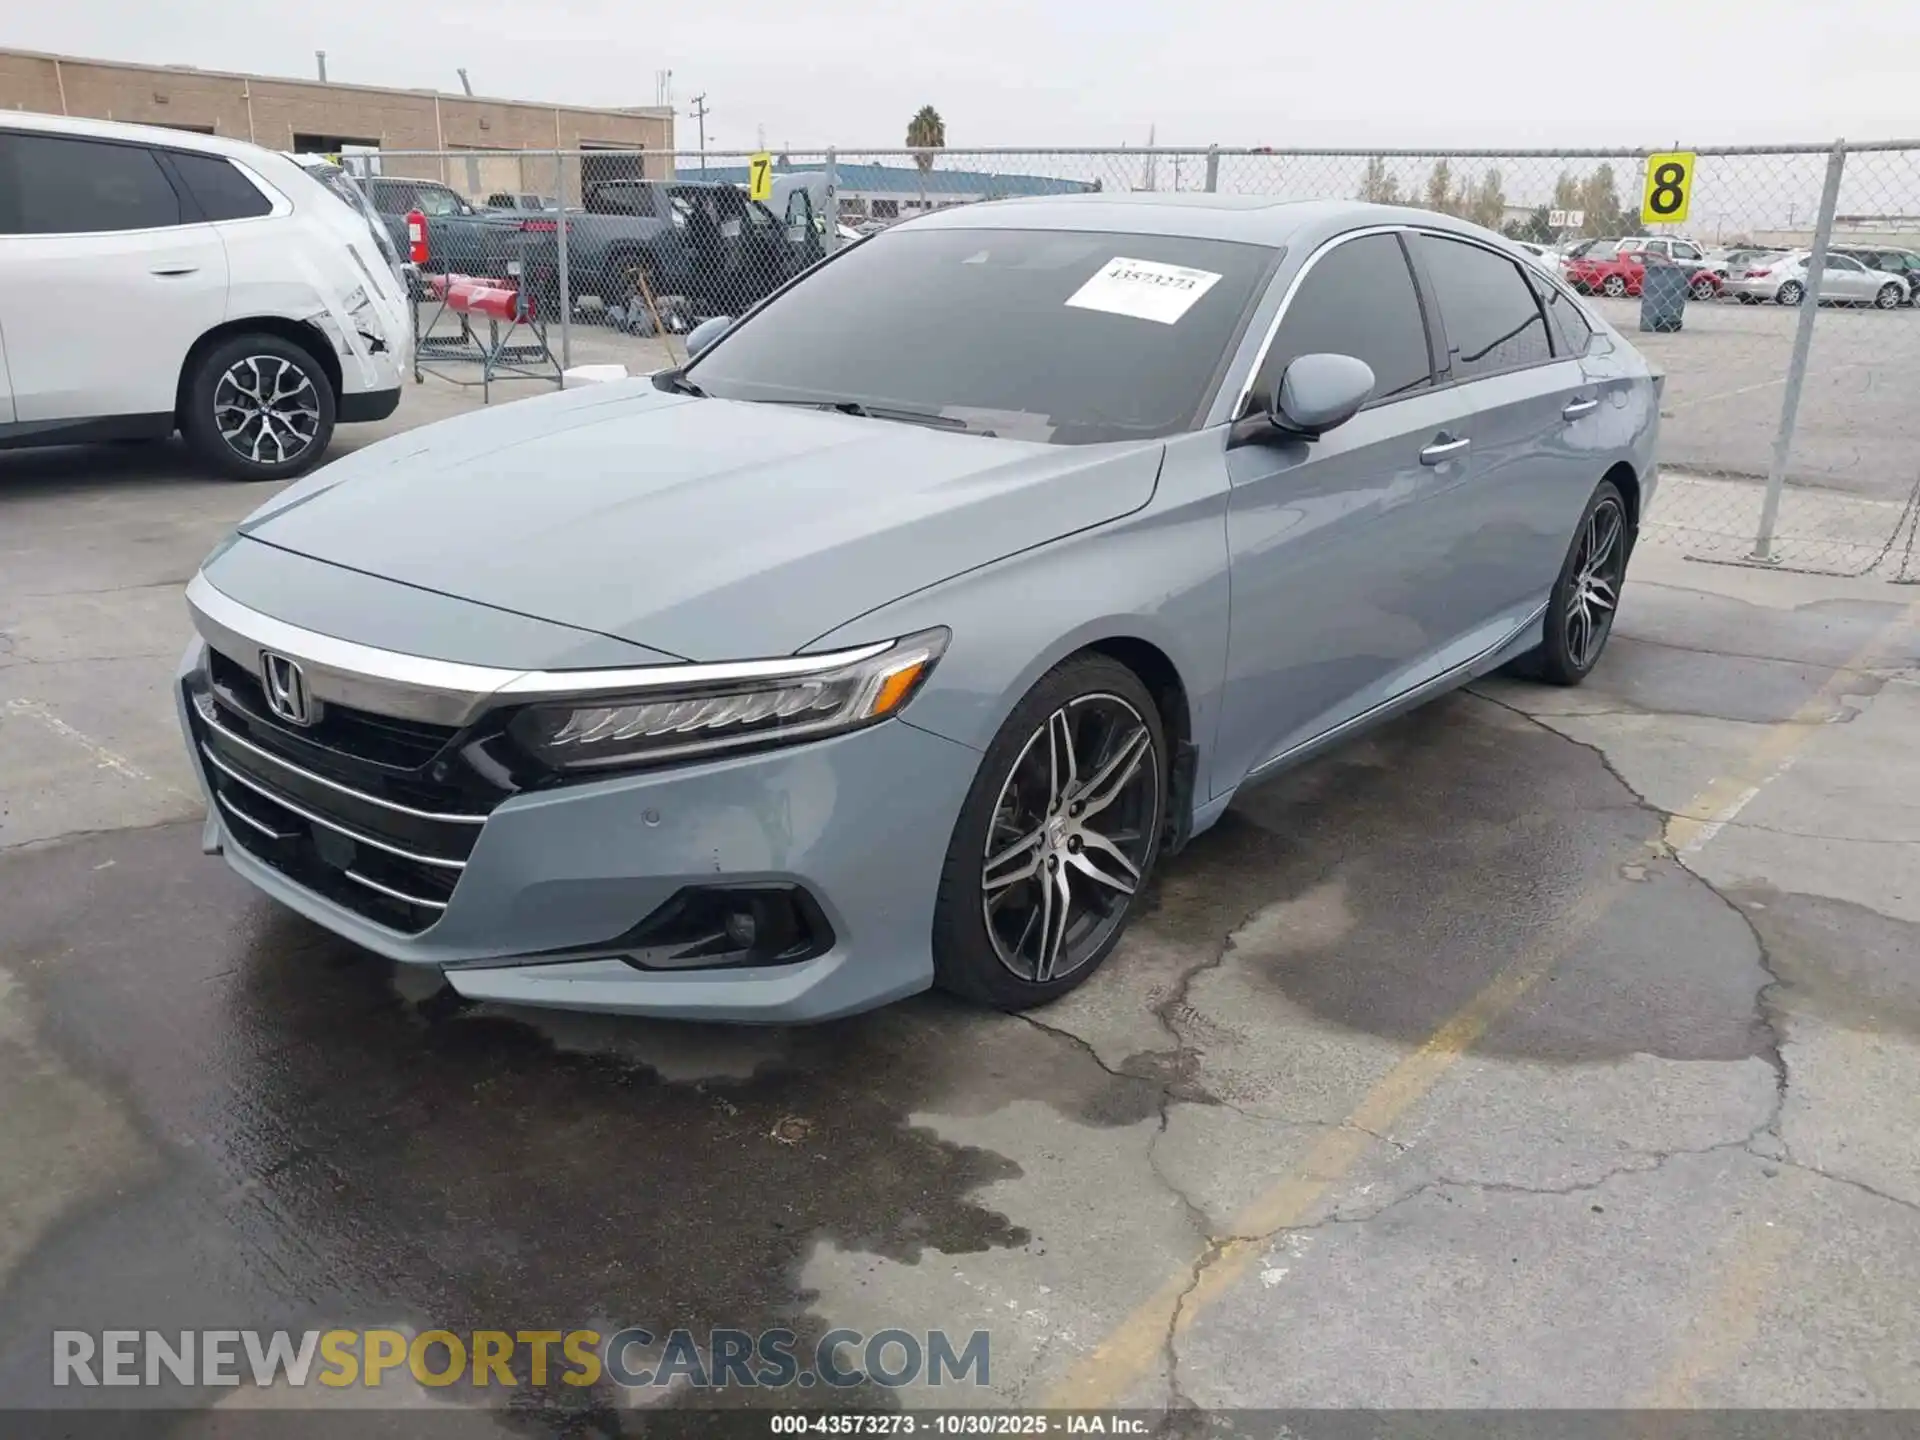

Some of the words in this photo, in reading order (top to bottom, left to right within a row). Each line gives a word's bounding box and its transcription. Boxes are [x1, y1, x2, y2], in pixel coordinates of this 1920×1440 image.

[753, 160, 767, 193] 7
[1650, 163, 1685, 214] 8
[1107, 267, 1196, 290] 43573273
